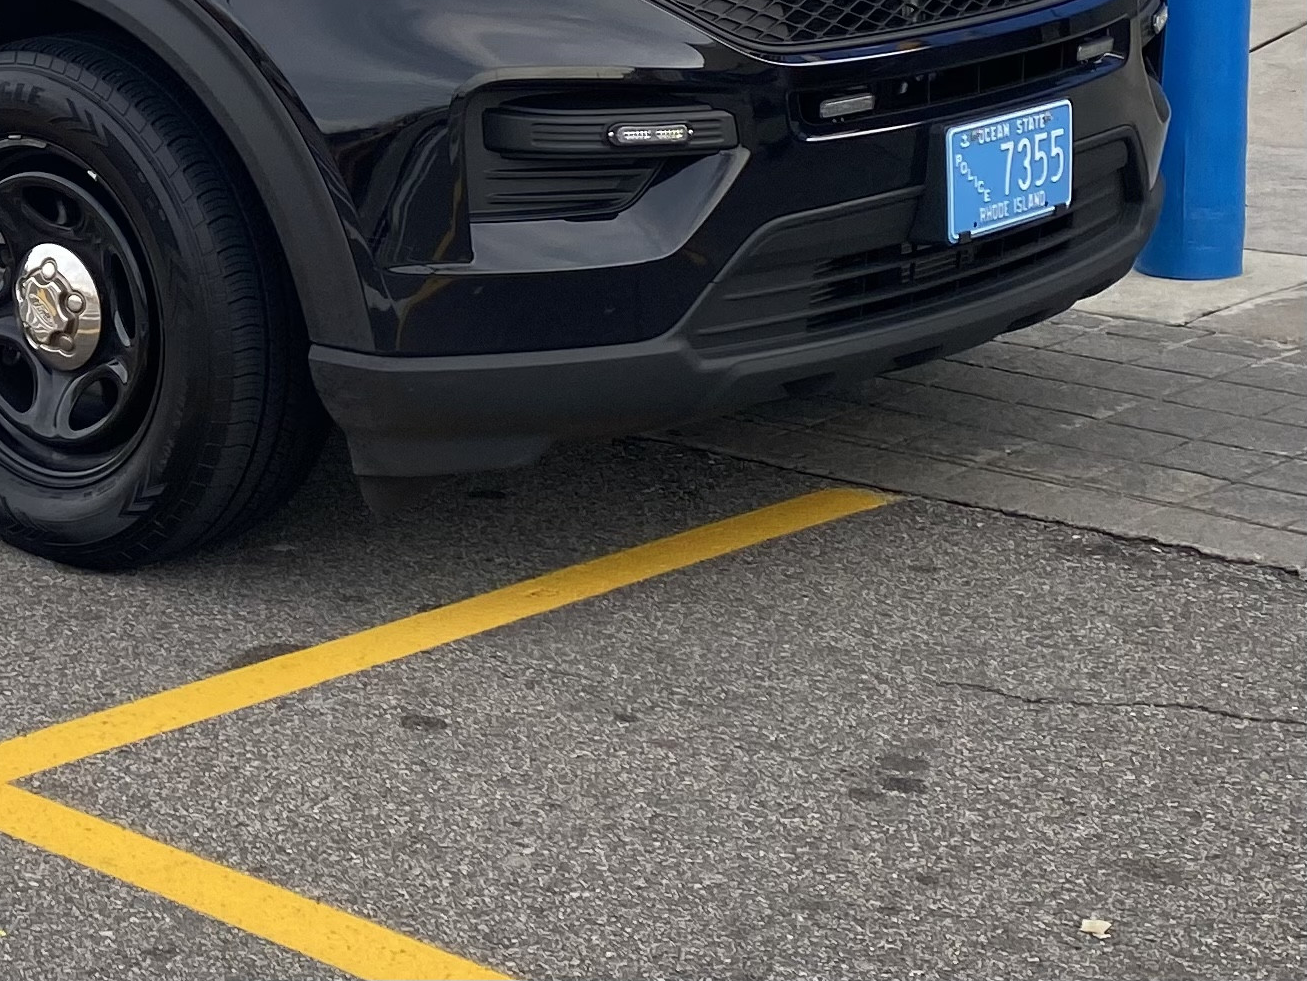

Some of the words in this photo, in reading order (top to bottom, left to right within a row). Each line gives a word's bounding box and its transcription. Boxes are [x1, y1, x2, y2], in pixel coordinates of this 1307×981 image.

[977, 122, 1011, 145] OCEAN
[1016, 114, 1047, 135] STATE
[955, 153, 992, 203] POLICE
[1000, 127, 1065, 197] 7355
[979, 200, 1010, 223] RHODE
[1013, 190, 1047, 214] ISLAND
